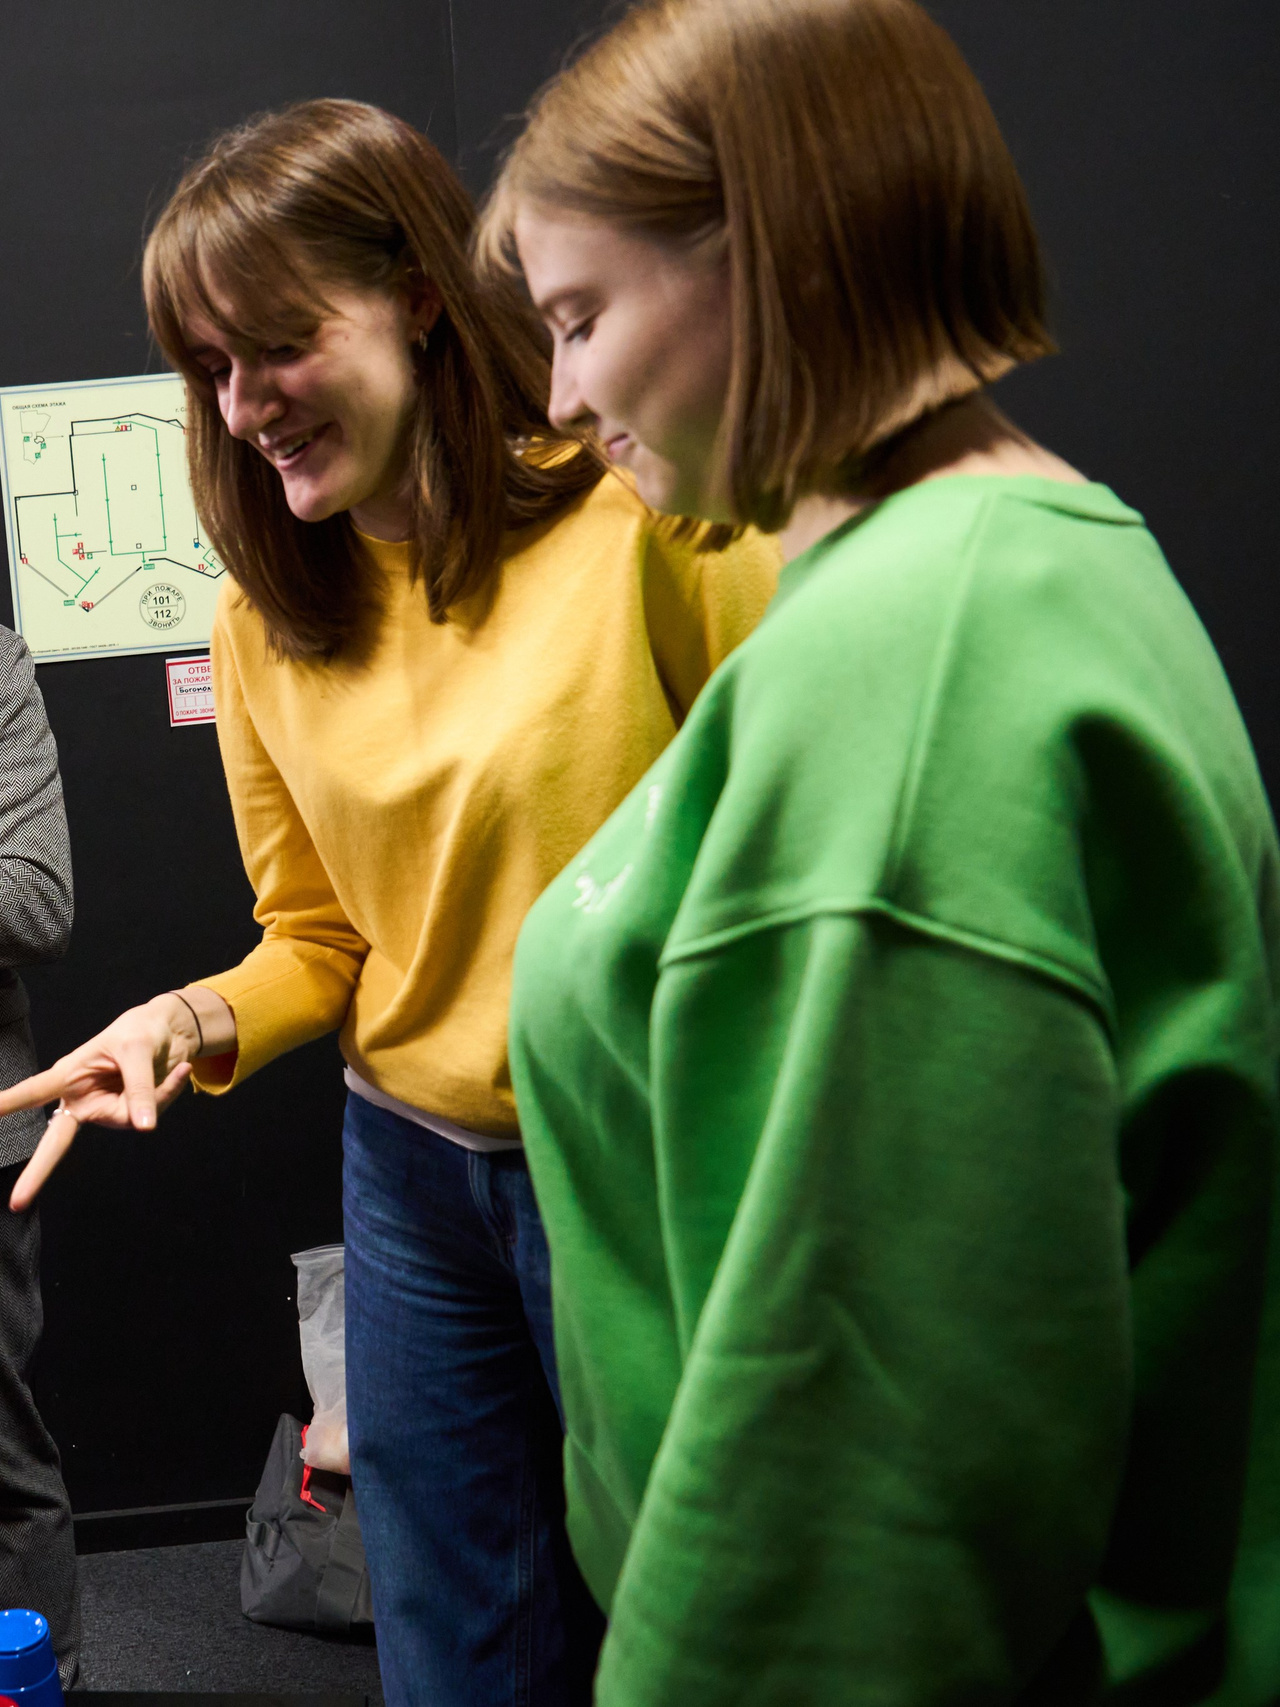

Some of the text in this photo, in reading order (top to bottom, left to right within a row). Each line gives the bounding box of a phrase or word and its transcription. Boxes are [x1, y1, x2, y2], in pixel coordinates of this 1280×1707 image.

[141, 585, 183, 605] ПРИ ПОЖАРЕ
[152, 595, 170, 605] 101
[154, 609, 172, 619] 112
[148, 616, 180, 628] ЗВОНИТЬ
[183, 675, 212, 684] ПОЖАР
